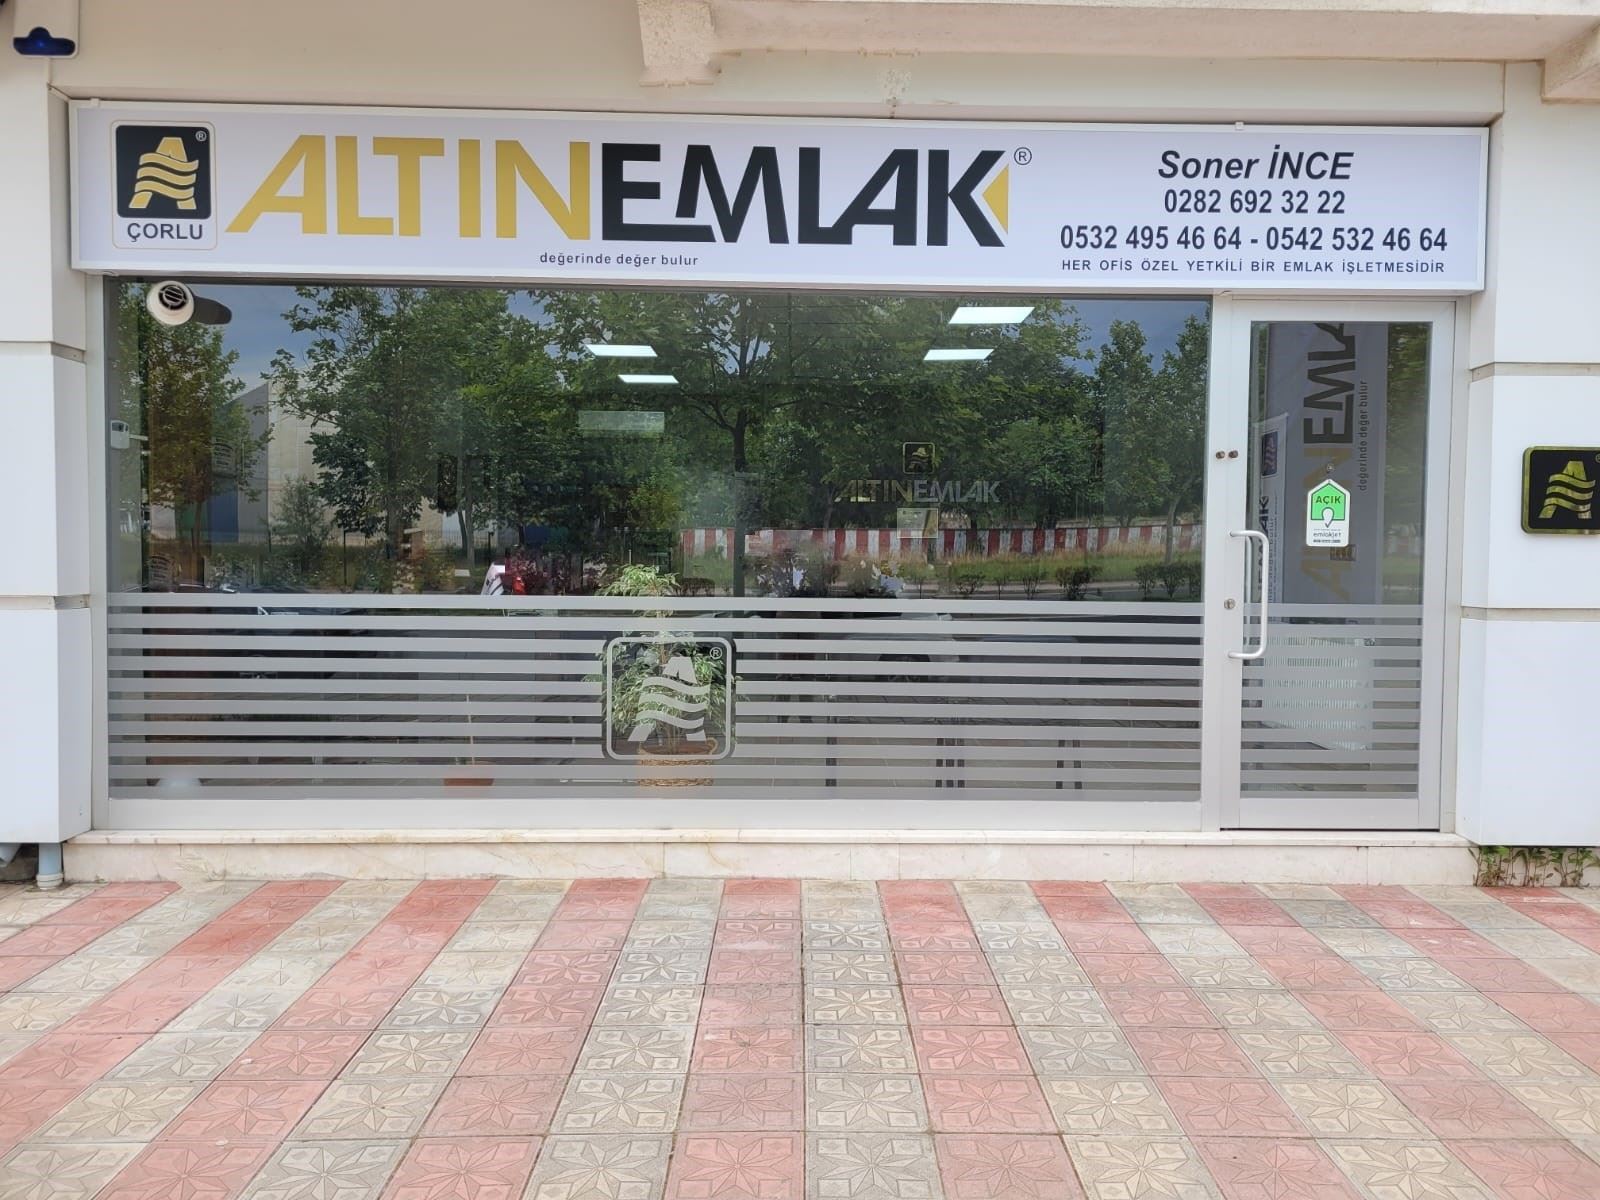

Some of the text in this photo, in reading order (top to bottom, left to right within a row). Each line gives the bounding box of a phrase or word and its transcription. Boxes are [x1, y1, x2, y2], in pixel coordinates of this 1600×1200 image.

[1158, 144, 1355, 180] Soner İNCE
[1164, 189, 1345, 214] 0282 692 32 22
[126, 222, 204, 243] ÇORLU
[1060, 224, 1118, 249] 0532
[1125, 225, 1169, 249] 495
[1176, 225, 1205, 249] 46
[1213, 226, 1242, 250] 64
[1266, 226, 1323, 250] 0542
[1331, 227, 1374, 251] 532
[1382, 227, 1411, 251] 46
[1419, 227, 1447, 251] 64
[540, 251, 699, 267] değerinde değer bulur
[1062, 257, 1445, 275] HER OFİS ÖZEL YETKİLİ BİR EMLAK İŞLETMESİDİR
[1315, 495, 1342, 505] AÇIK
